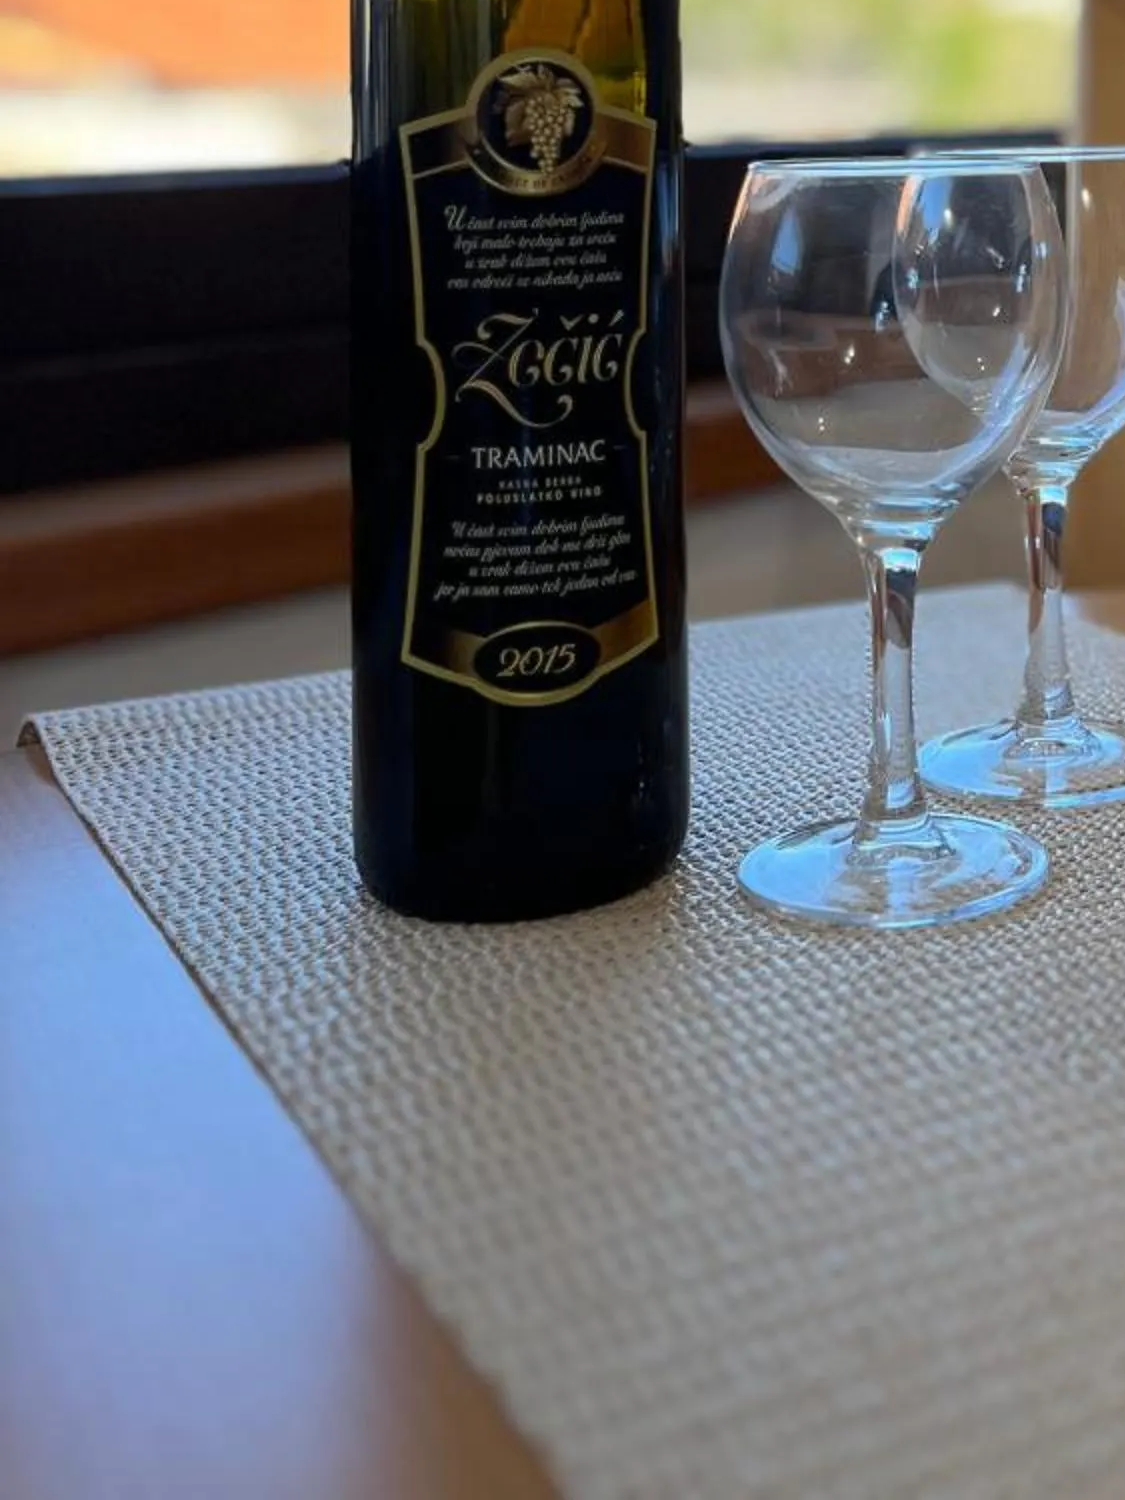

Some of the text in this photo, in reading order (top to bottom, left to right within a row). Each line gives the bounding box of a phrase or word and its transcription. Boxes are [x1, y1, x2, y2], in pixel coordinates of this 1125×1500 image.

[444, 203, 467, 231] U
[471, 439, 607, 470] TRAMINAC
[475, 485, 603, 505] POLUSLATKO VINO
[496, 643, 577, 678] 2015
